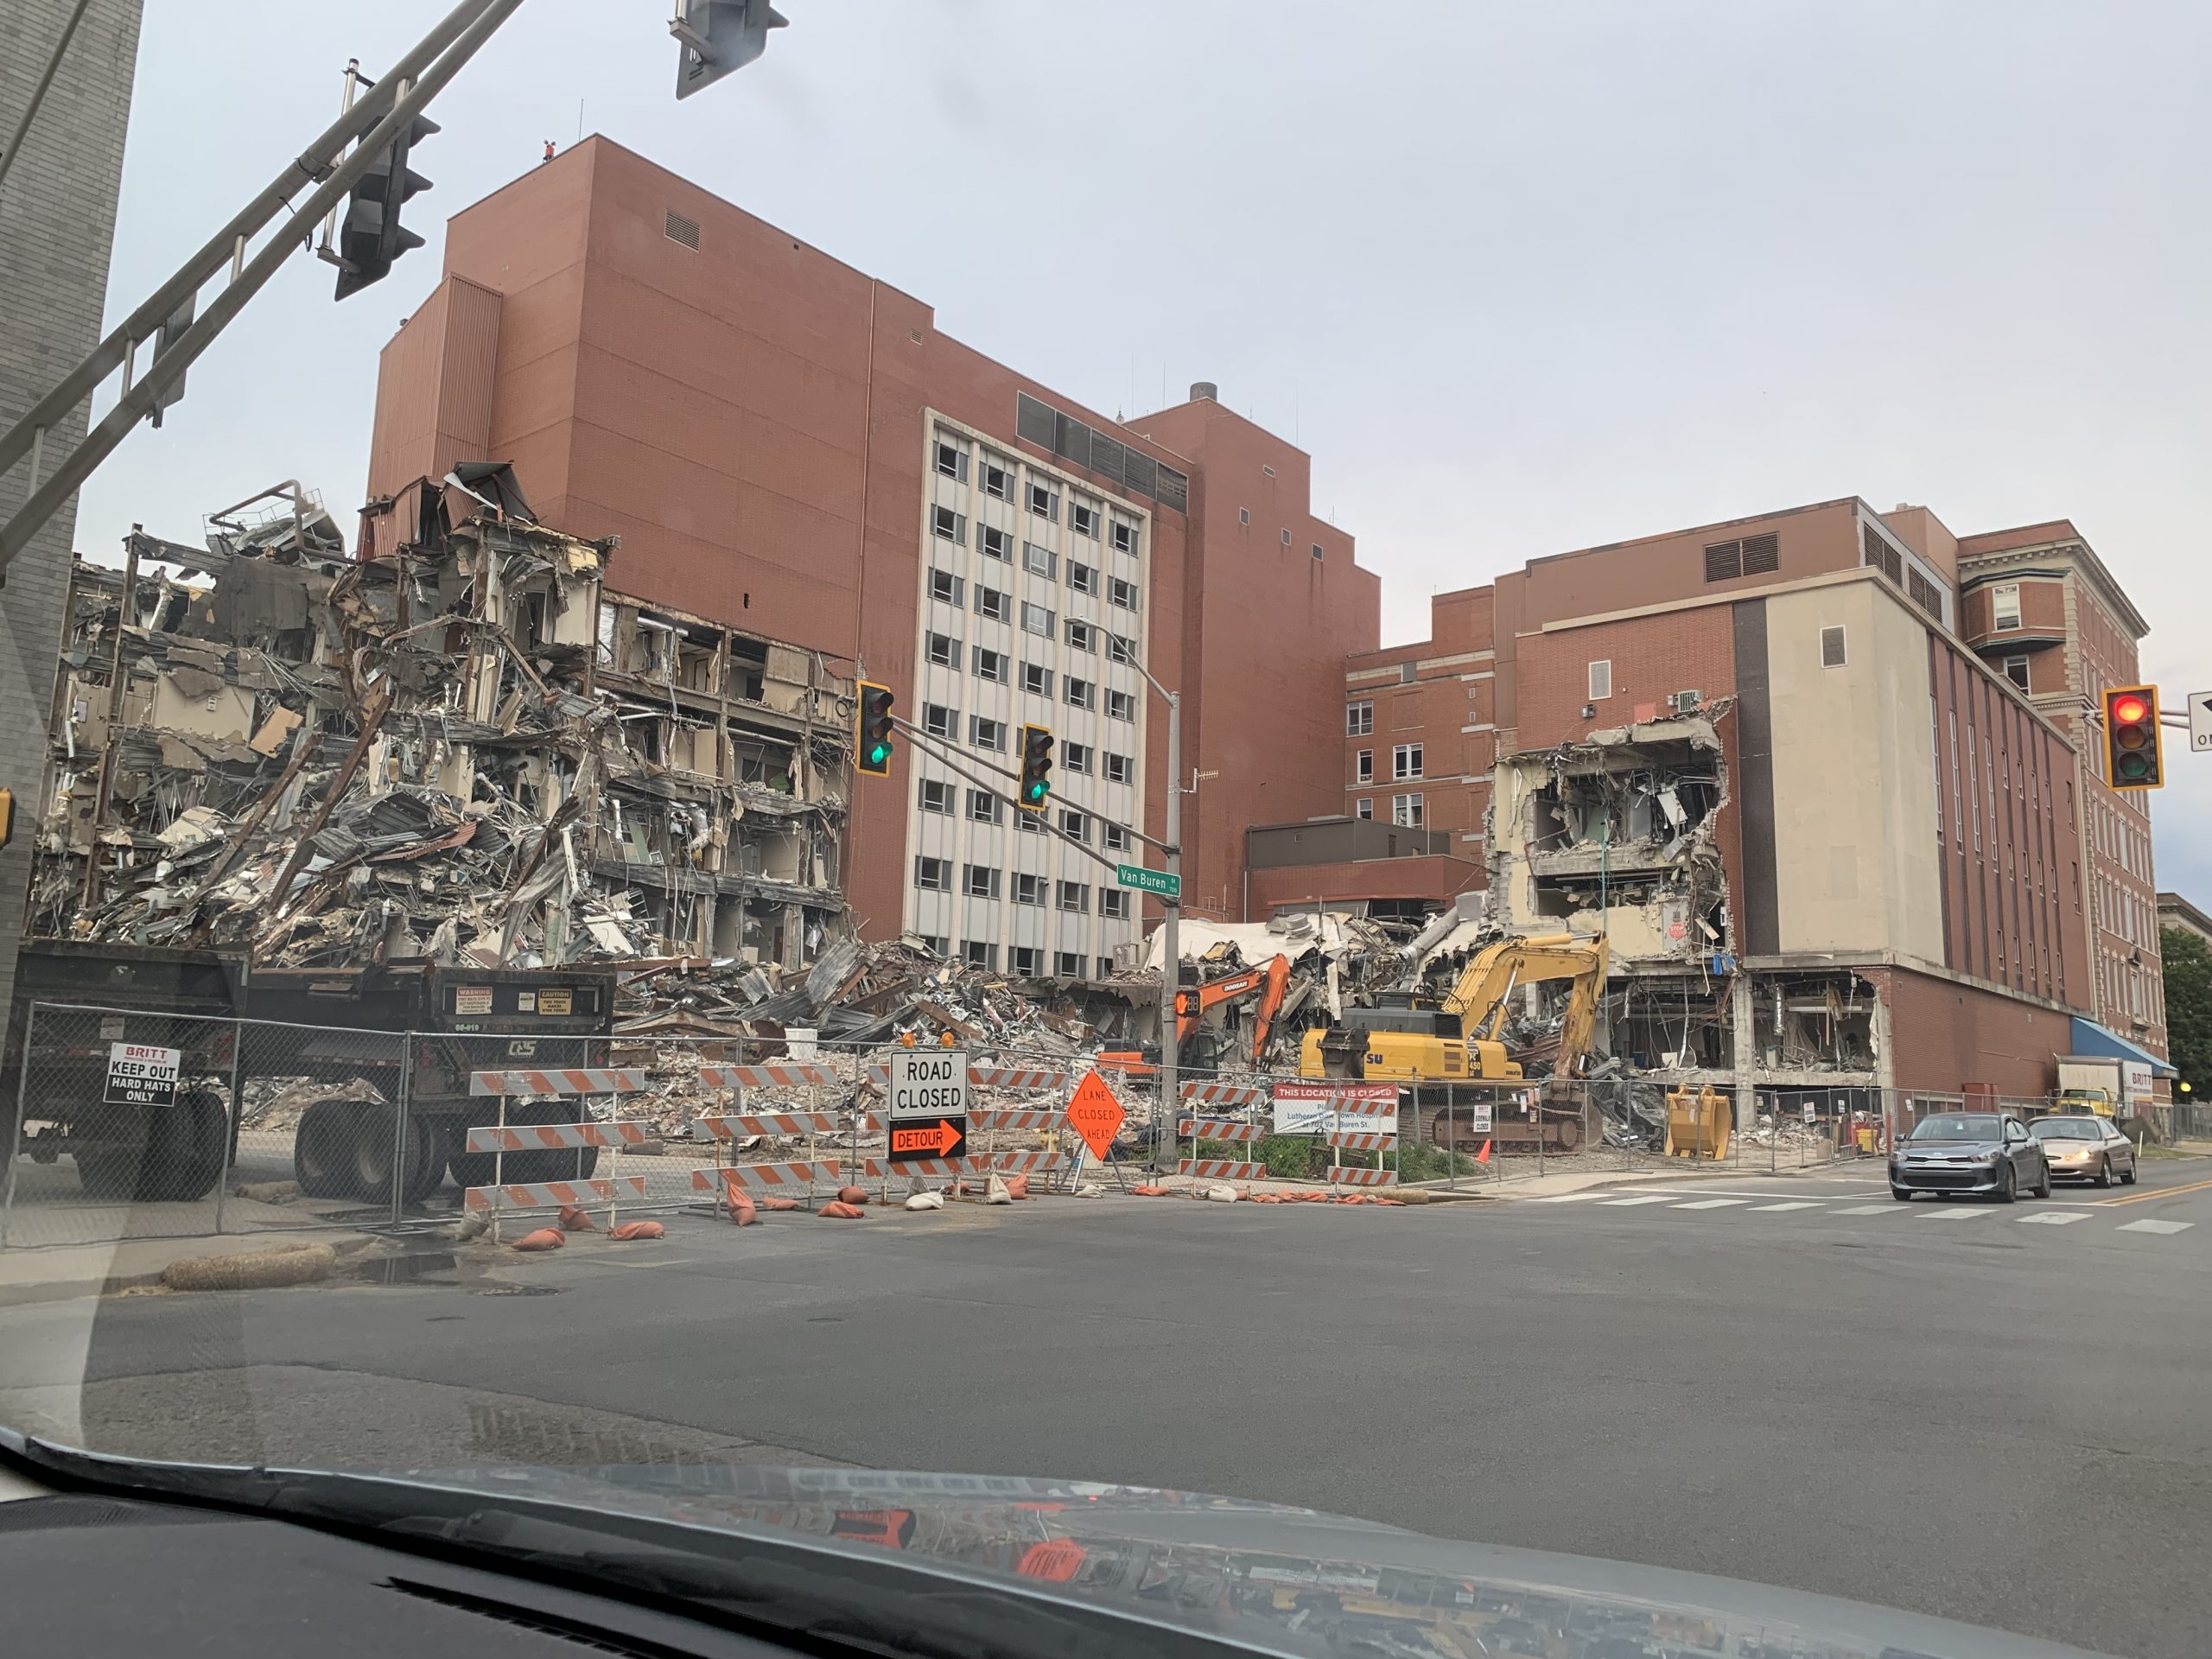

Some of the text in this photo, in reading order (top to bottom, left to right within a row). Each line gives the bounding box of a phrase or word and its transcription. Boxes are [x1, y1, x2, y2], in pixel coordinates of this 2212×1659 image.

[1121, 868, 1137, 884] Van
[1141, 873, 1166, 889] Buren
[125, 1046, 168, 1059] BRITT
[111, 1061, 176, 1079] KEEP OUT
[907, 1061, 952, 1081] ROAD
[111, 1077, 171, 1092] HARD HATS
[2132, 1072, 2152, 1086] BRITT
[126, 1090, 155, 1102] ONLY
[897, 1087, 961, 1109] CLOSED
[1083, 1090, 1106, 1101] LANE
[1357, 1089, 1392, 1097] CLOSED
[1077, 1109, 1116, 1120] CLOSED
[898, 1131, 944, 1148] DETOUR
[1087, 1128, 1110, 1140] AHEAD
